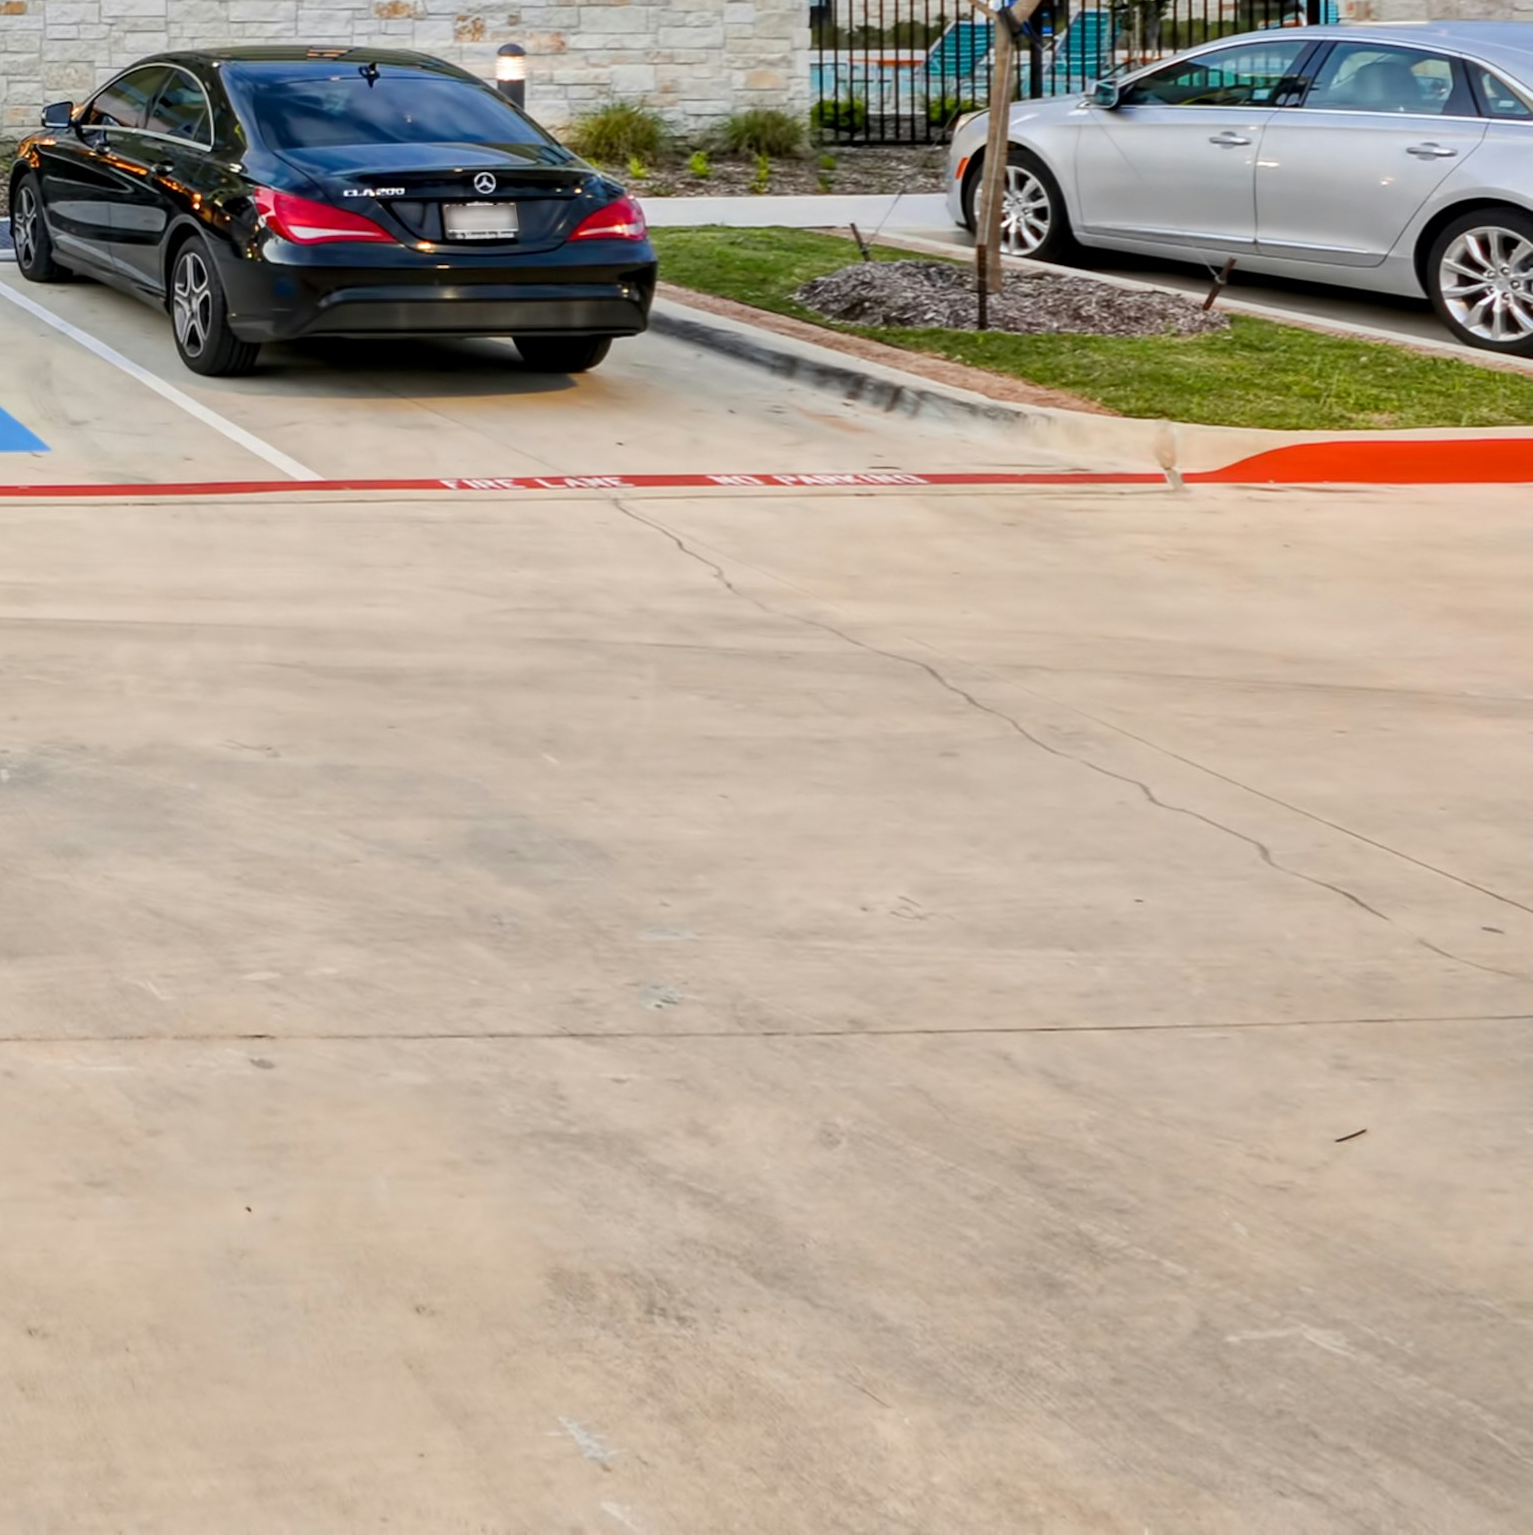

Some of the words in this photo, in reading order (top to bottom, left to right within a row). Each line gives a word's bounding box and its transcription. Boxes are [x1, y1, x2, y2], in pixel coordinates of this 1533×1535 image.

[439, 478, 527, 490] FIRE
[534, 477, 636, 489] LANE
[771, 474, 931, 486] PARKING
